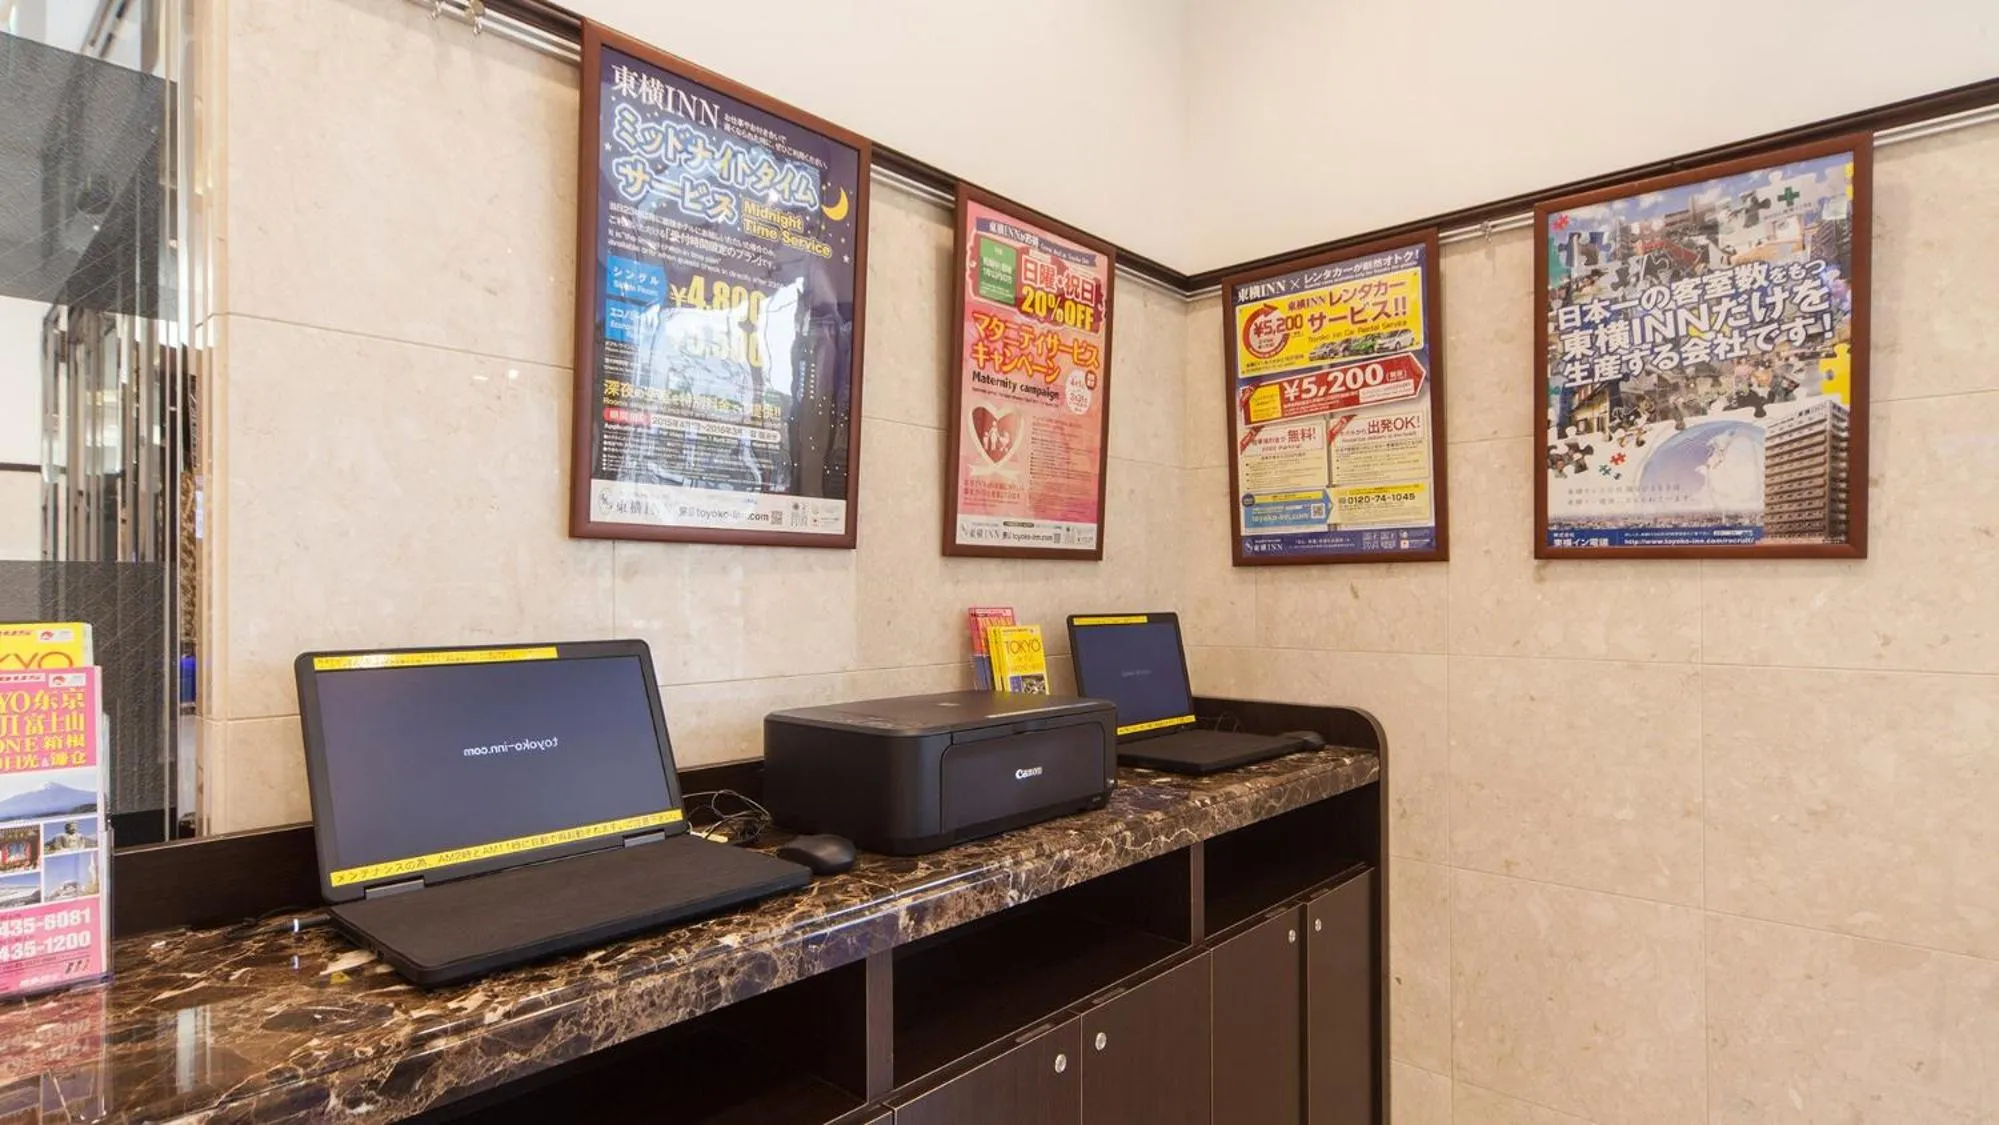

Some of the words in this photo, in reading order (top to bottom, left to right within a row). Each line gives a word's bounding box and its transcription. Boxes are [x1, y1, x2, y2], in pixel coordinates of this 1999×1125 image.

[611, 64, 720, 129] 東横INN
[613, 103, 819, 212] ミッドナイトタイム
[612, 155, 737, 224] サービス
[744, 201, 804, 231] Midnight
[743, 219, 779, 242] Time
[779, 229, 832, 257] Service
[1021, 285, 1095, 330] 20%OFF
[1237, 278, 1285, 303] 東横INN
[1328, 274, 1406, 306] レンタカー
[1558, 258, 1827, 330] 日本一の客室数をもつ
[1252, 312, 1303, 339] ¥5,200
[1307, 294, 1407, 333] サービス!!
[1560, 280, 1832, 361] 東横INNだけを
[972, 311, 1100, 369] マタニティサービス
[1563, 312, 1836, 389] 生産する会社です!
[971, 340, 1061, 384] キャンペーン
[972, 370, 1018, 394] Maternity
[1019, 381, 1060, 402] campaign
[1281, 361, 1384, 403] ¥5,200
[1367, 414, 1420, 434] 出発OK!
[1347, 491, 1415, 505] 0120-74-1045
[1004, 639, 1042, 656] TOKYO
[1015, 766, 1043, 779] Canon
